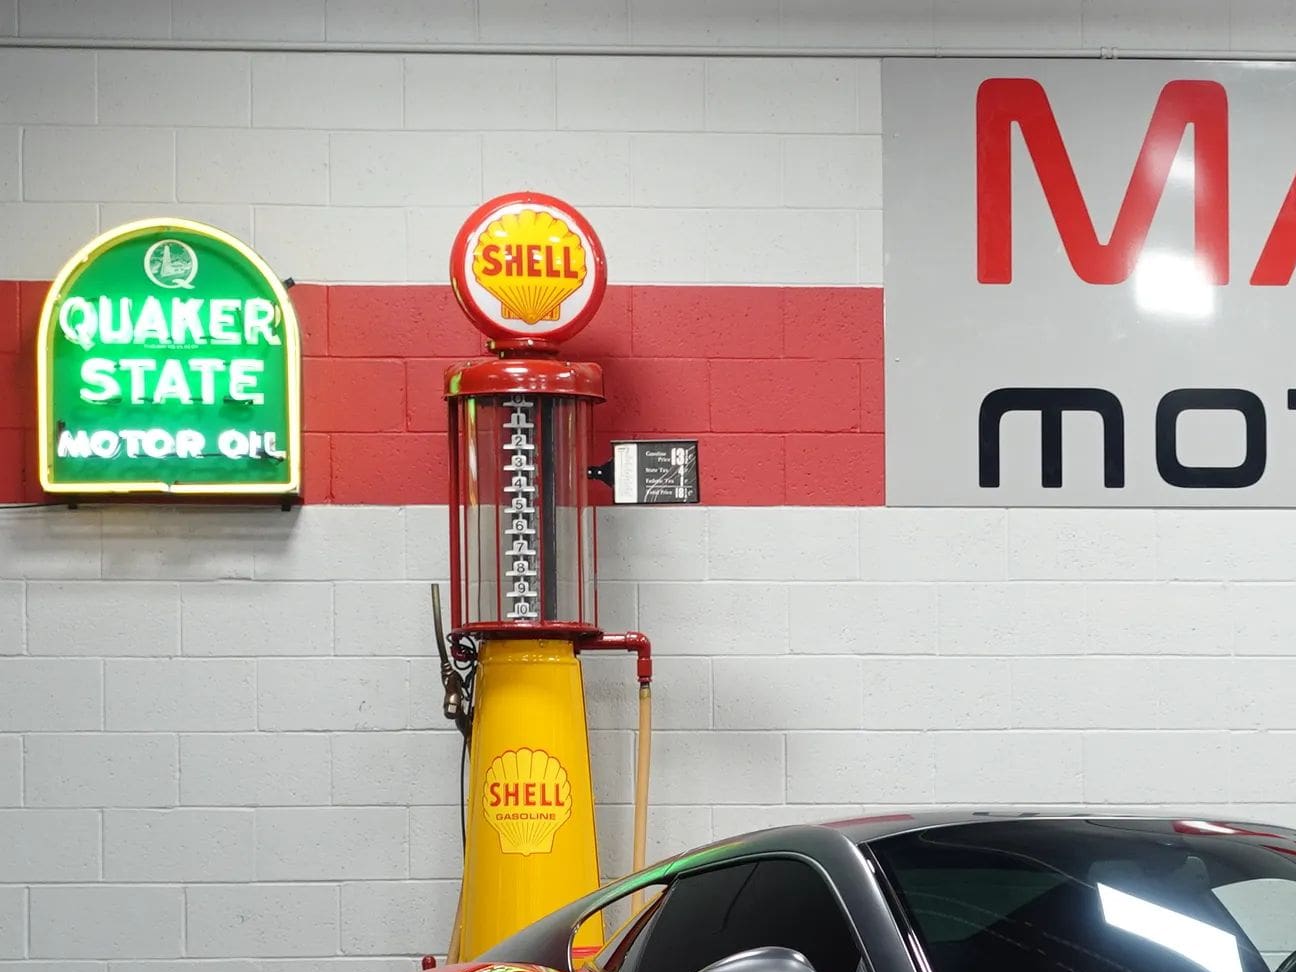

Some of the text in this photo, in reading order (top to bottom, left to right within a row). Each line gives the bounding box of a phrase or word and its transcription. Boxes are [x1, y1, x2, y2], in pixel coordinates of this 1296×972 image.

[482, 244, 579, 279] SHELL
[59, 295, 282, 351] QUAKER
[80, 358, 264, 405] STATE
[57, 429, 287, 459] MOTOR OIL
[514, 436, 523, 446] 2
[514, 457, 524, 468] 3
[514, 479, 523, 490] 4
[515, 500, 524, 511] 5
[515, 521, 525, 532] 6
[516, 542, 525, 553] 7
[516, 563, 526, 573] 8
[517, 583, 526, 594] 9
[516, 604, 528, 615] 10
[489, 783, 565, 807] SHELL
[495, 812, 557, 821] GASOLINE
